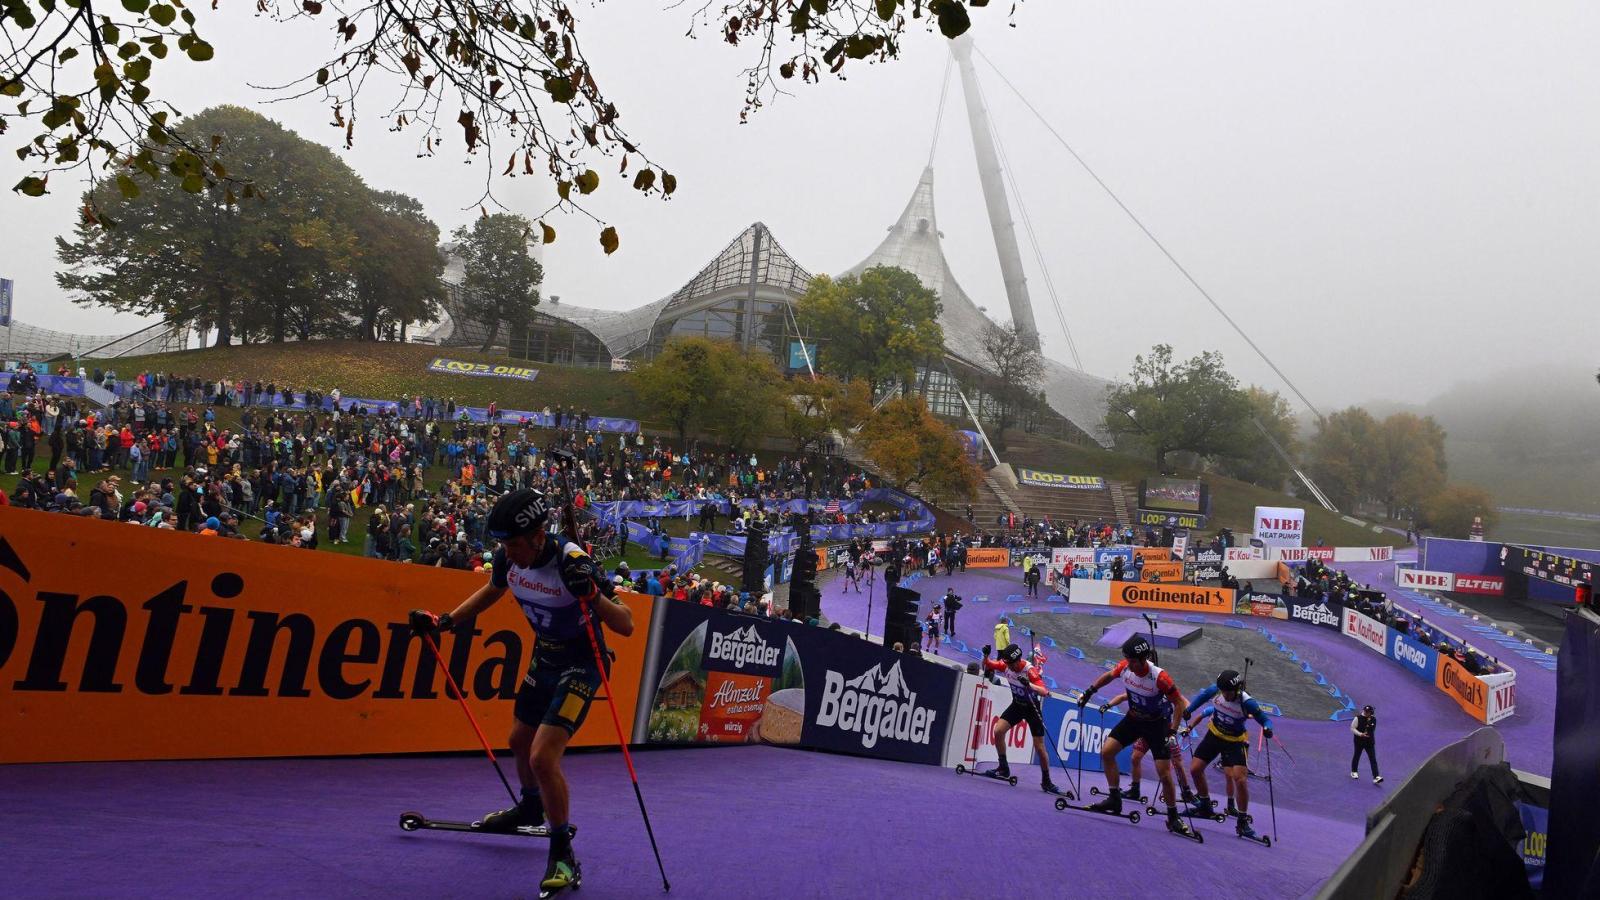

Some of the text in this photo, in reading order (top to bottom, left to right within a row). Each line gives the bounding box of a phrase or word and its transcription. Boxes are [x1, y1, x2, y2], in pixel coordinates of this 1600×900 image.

[1022, 470, 1101, 484] LOOP ONE
[515, 498, 547, 528] SWE
[1140, 515, 1198, 528] LOOP ONE
[1260, 518, 1302, 530] NIBE
[1259, 532, 1301, 540] HEAT PUMPS
[1281, 549, 1306, 560] NIBE
[1308, 550, 1333, 559] ELTEN
[519, 576, 561, 596] Kaufland
[1404, 574, 1447, 586] NIBE
[1456, 579, 1503, 590] ELTEN
[1122, 586, 1210, 605] Continental
[1293, 604, 1339, 626] Bergader
[1358, 616, 1384, 648] Kaufland
[709, 632, 780, 668] Bergader
[1134, 642, 1149, 654] SUI
[1394, 635, 1427, 669] CONRAD
[710, 679, 764, 708] Almzeit
[816, 670, 936, 748] Bergader
[725, 722, 742, 733] würzig
